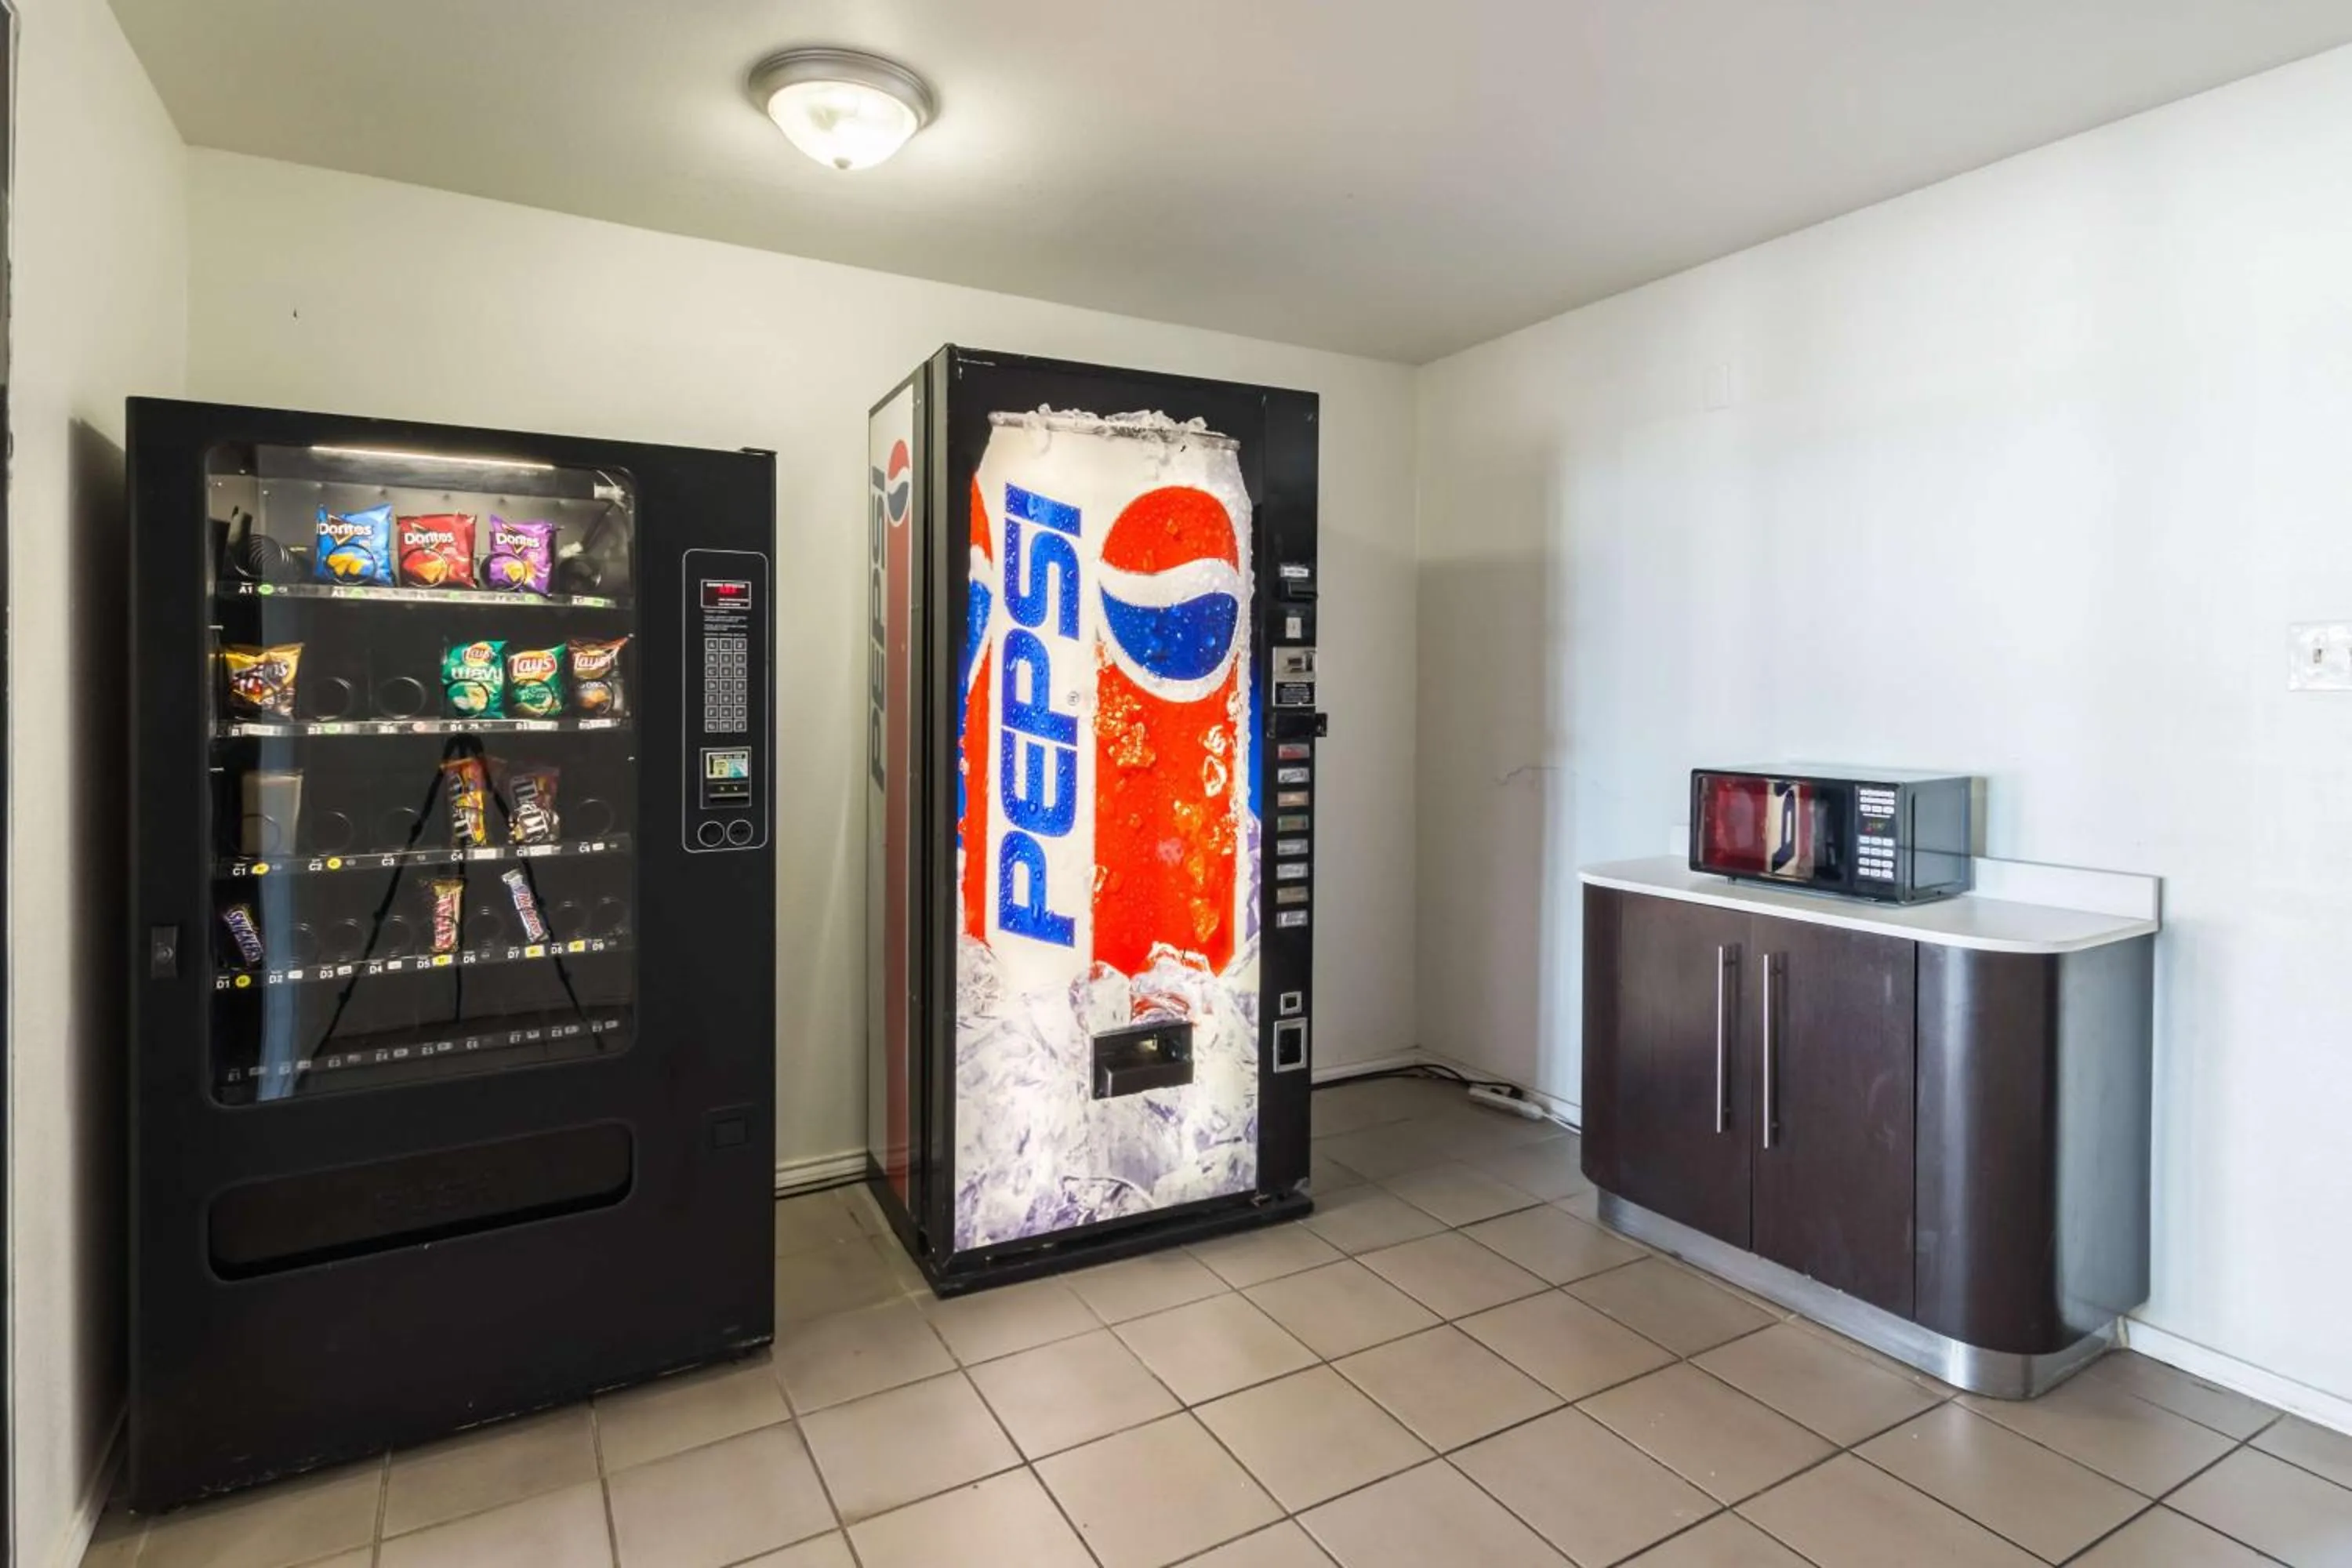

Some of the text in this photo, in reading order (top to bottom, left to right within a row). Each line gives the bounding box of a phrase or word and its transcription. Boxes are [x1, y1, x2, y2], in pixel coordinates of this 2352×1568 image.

[318, 523, 373, 535] Doritos
[404, 532, 455, 545] Doritos
[495, 532, 540, 548] Doritos
[238, 586, 253, 594] A1
[871, 466, 886, 792] PEPSI
[998, 482, 1082, 949] PEPSI
[451, 852, 463, 862] C4
[232, 867, 245, 876] C1
[463, 954, 476, 964] D6
[507, 949, 520, 959] D7
[369, 964, 382, 974] D4
[416, 959, 430, 969] D5
[320, 969, 333, 978] D3
[216, 980, 230, 989] D1
[269, 975, 283, 984] D2
[376, 1052, 388, 1062] E4
[328, 1058, 341, 1068] E3
